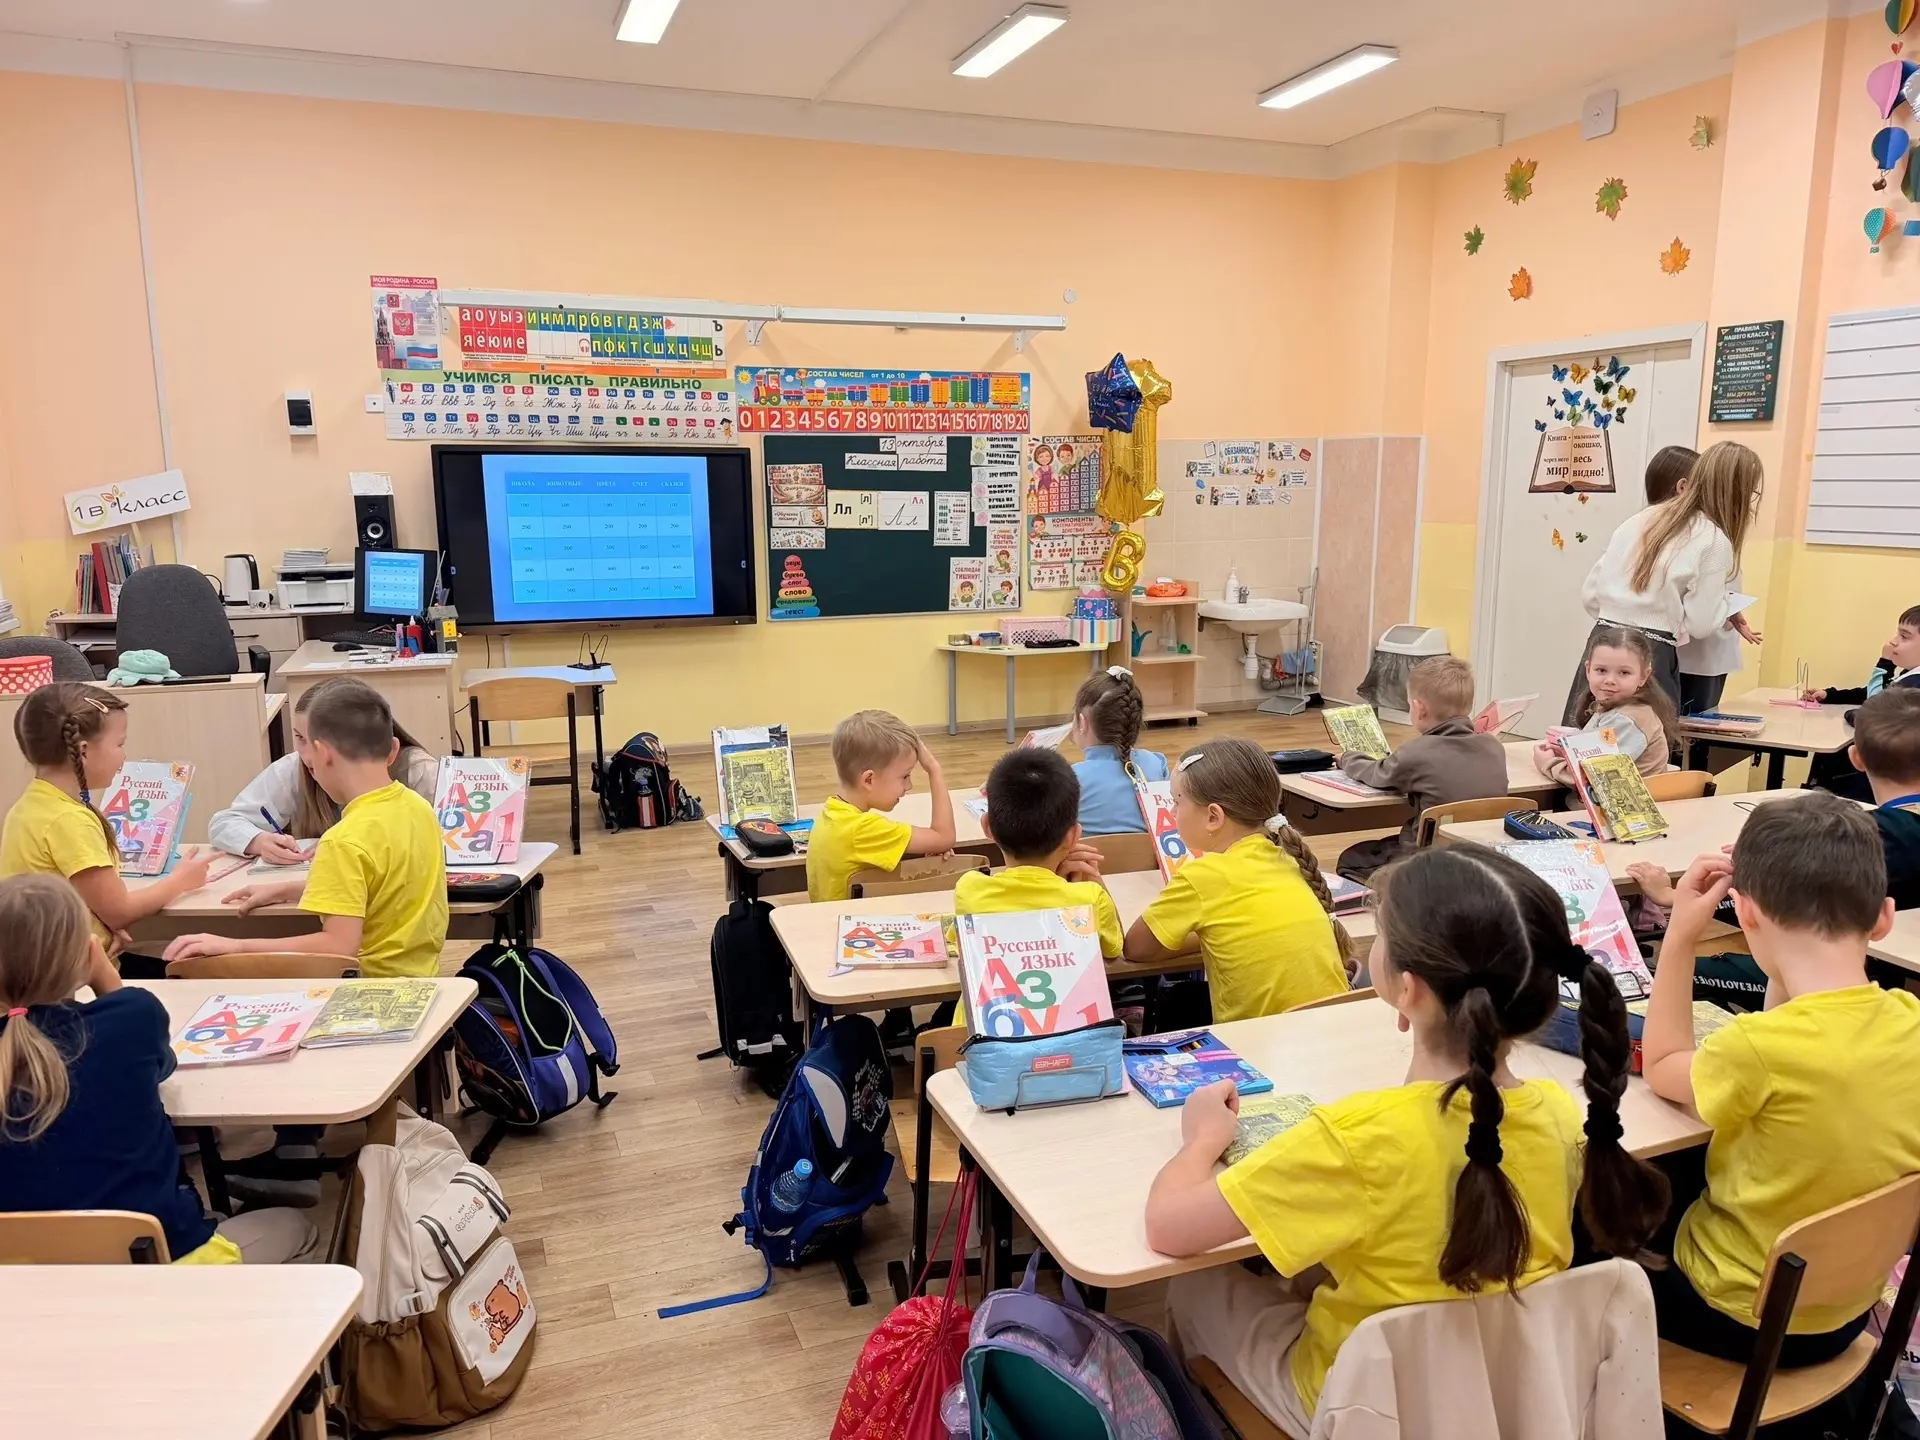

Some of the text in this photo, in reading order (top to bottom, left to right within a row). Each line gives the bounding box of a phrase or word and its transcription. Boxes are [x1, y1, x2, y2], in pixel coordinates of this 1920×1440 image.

[462, 309, 723, 331] а о у ы э й н м л р б в г д з ж ъ
[1734, 324, 1760, 333] ПРАВИЛА
[1723, 330, 1769, 341] НАШЕГО КЛАССА
[443, 371, 702, 389] УЧИМСЯ ПИСАТЬ ПРАВИЛЬНО
[808, 370, 838, 378] СОСТАВ
[740, 410, 1028, 431] 0 1 2 3 4 5 6 7 8 9 10 11 12 13 14 15 16 17 18 19 20
[881, 438, 894, 451] 13
[1076, 435, 1102, 443] ЧИСЛА
[1547, 434, 1568, 442] Книга
[846, 454, 897, 467] Классная
[1573, 455, 1592, 464] весь
[1546, 466, 1604, 480] мир видно!
[116, 490, 187, 514] класс
[912, 496, 924, 505] Лл
[833, 503, 852, 515] Лл
[1572, 746, 1602, 761] Русский
[121, 775, 163, 790] Русский
[453, 770, 501, 783] Русский
[497, 812, 515, 844] 1
[917, 939, 938, 955] 1
[981, 935, 1058, 957] Русский
[222, 1001, 291, 1012] Русский
[270, 1021, 302, 1047] 1
